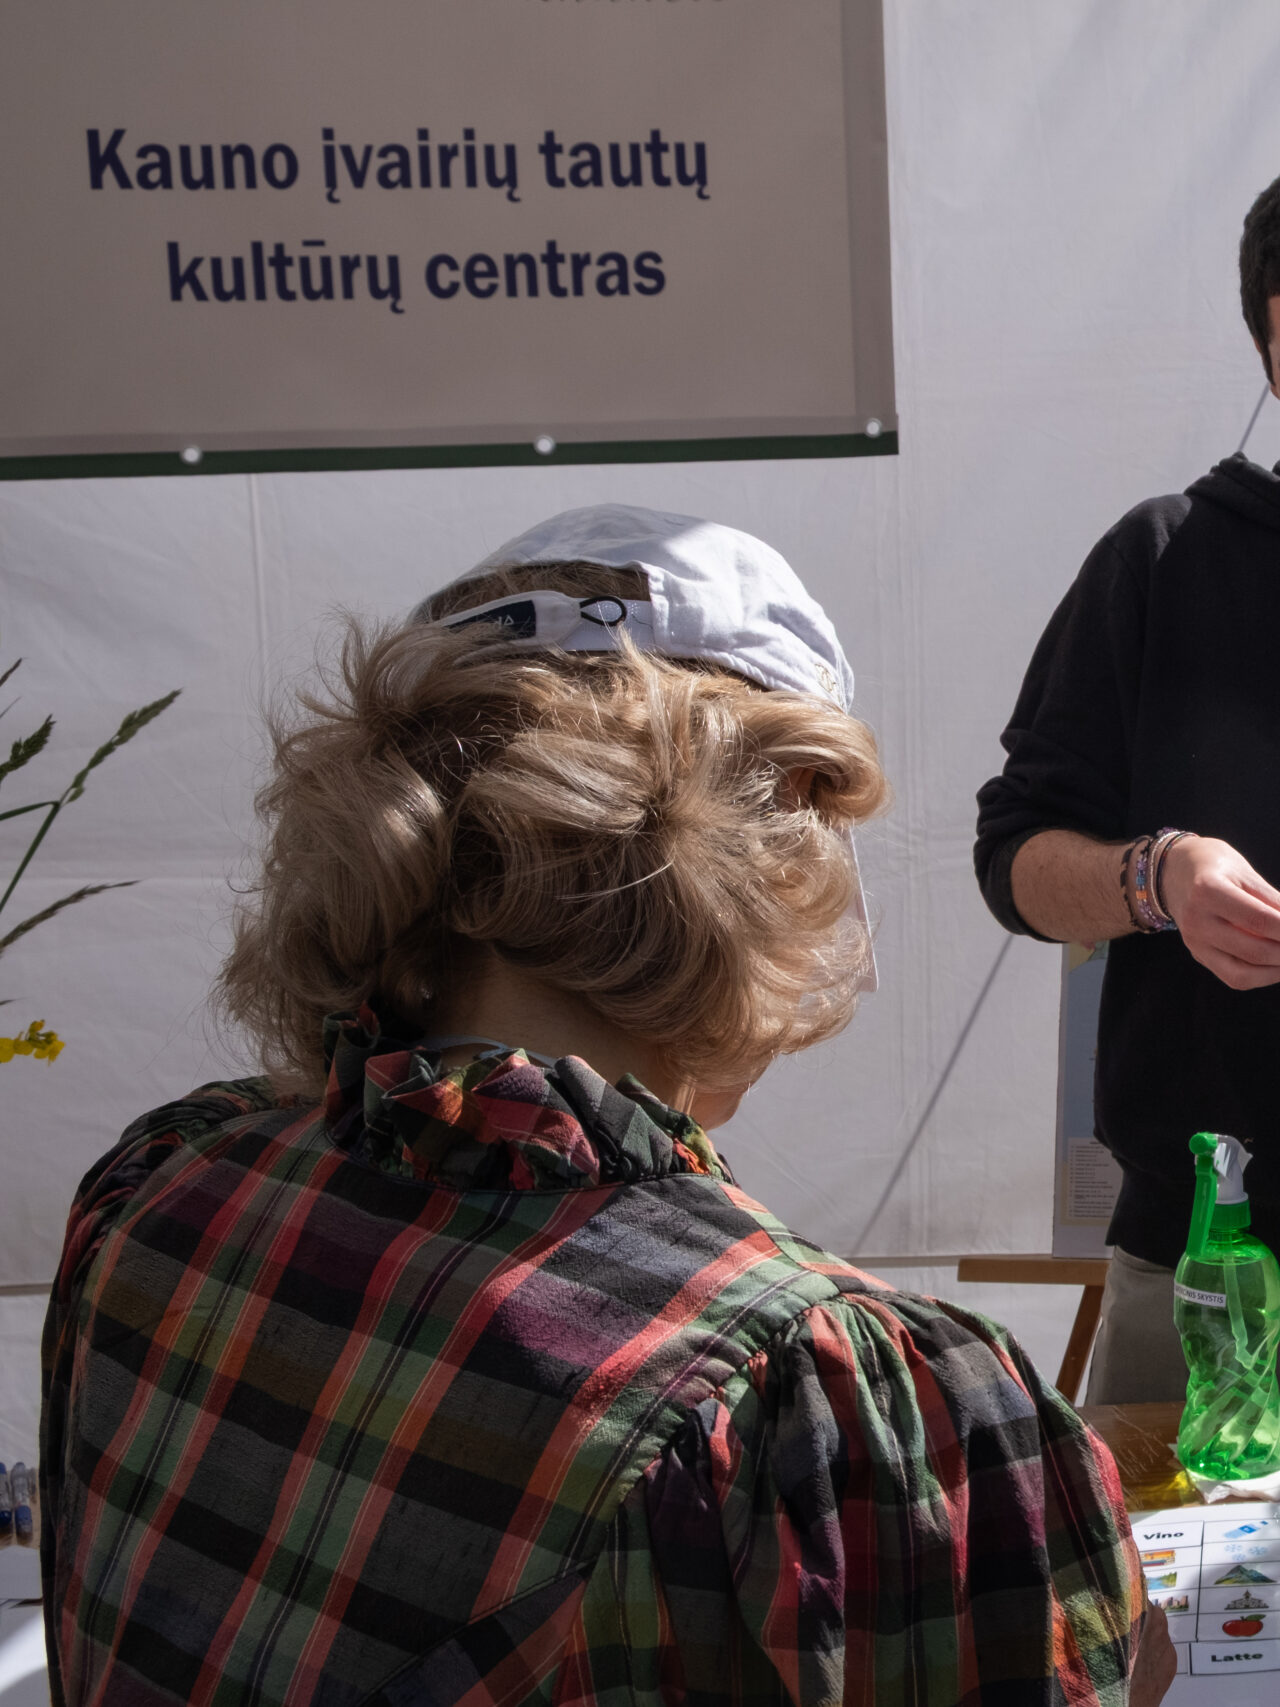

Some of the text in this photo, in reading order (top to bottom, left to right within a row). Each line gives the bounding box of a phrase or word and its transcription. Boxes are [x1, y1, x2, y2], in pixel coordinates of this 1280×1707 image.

[86, 127, 710, 203] Kauno įvairių tautų
[166, 240, 666, 314] kultūrų centras
[1197, 1292, 1224, 1304] SKYSTIS
[1143, 1529, 1184, 1541] Vino
[1210, 1651, 1264, 1663] Latte
